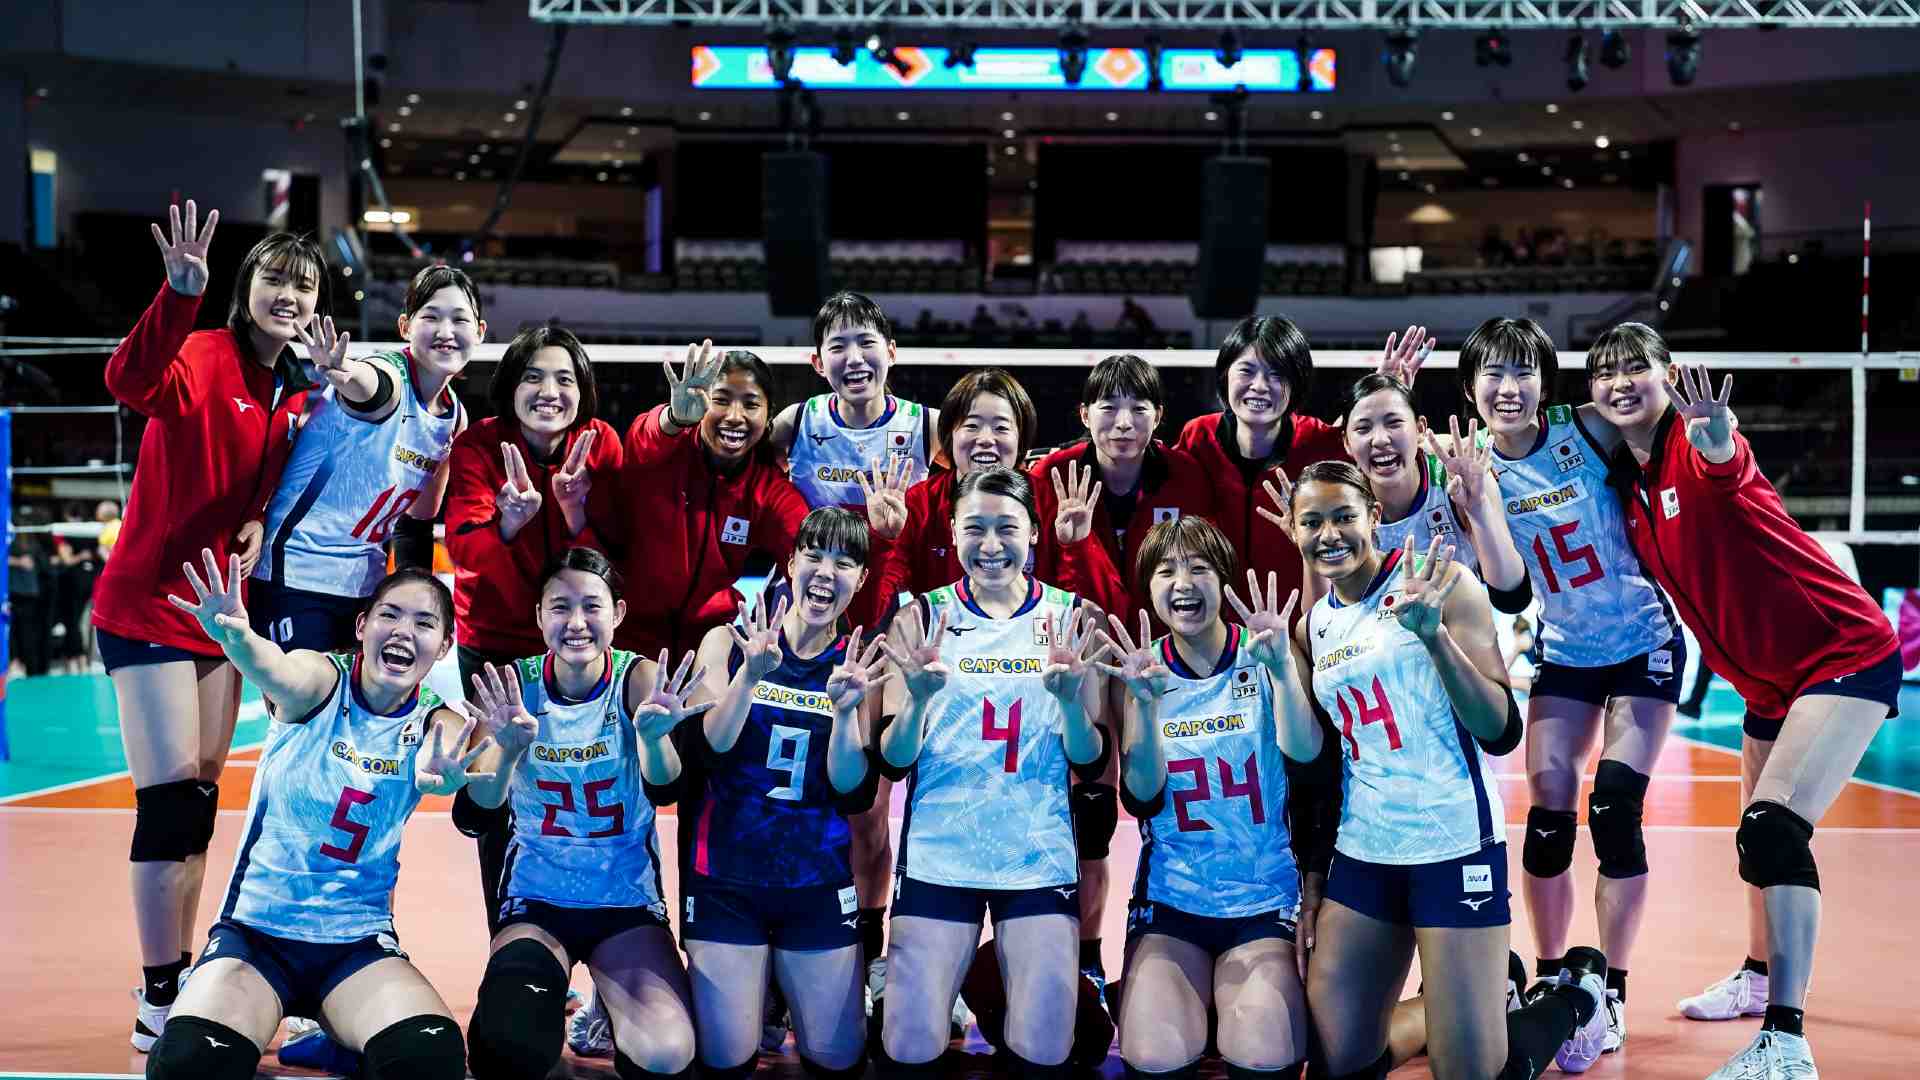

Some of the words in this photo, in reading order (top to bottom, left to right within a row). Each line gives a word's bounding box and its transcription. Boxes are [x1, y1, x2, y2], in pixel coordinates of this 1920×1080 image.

[1561, 454, 1584, 470] JPN
[1506, 484, 1577, 514] CAPCOM
[724, 535, 746, 545] JPN
[1532, 520, 1604, 593] 15
[269, 617, 294, 643] 10
[958, 657, 1040, 674] CAPCOM
[754, 685, 832, 711] CAPCOM
[1236, 687, 1257, 698] JPN
[1162, 714, 1243, 738] CAPCOM
[1336, 674, 1403, 762] 14
[402, 735, 416, 745] PN
[982, 695, 1022, 773] 4
[534, 741, 609, 764] CAPCOM
[766, 724, 811, 801] 9
[1165, 751, 1265, 833] 24
[536, 776, 624, 839] 25
[320, 786, 376, 865] 5
